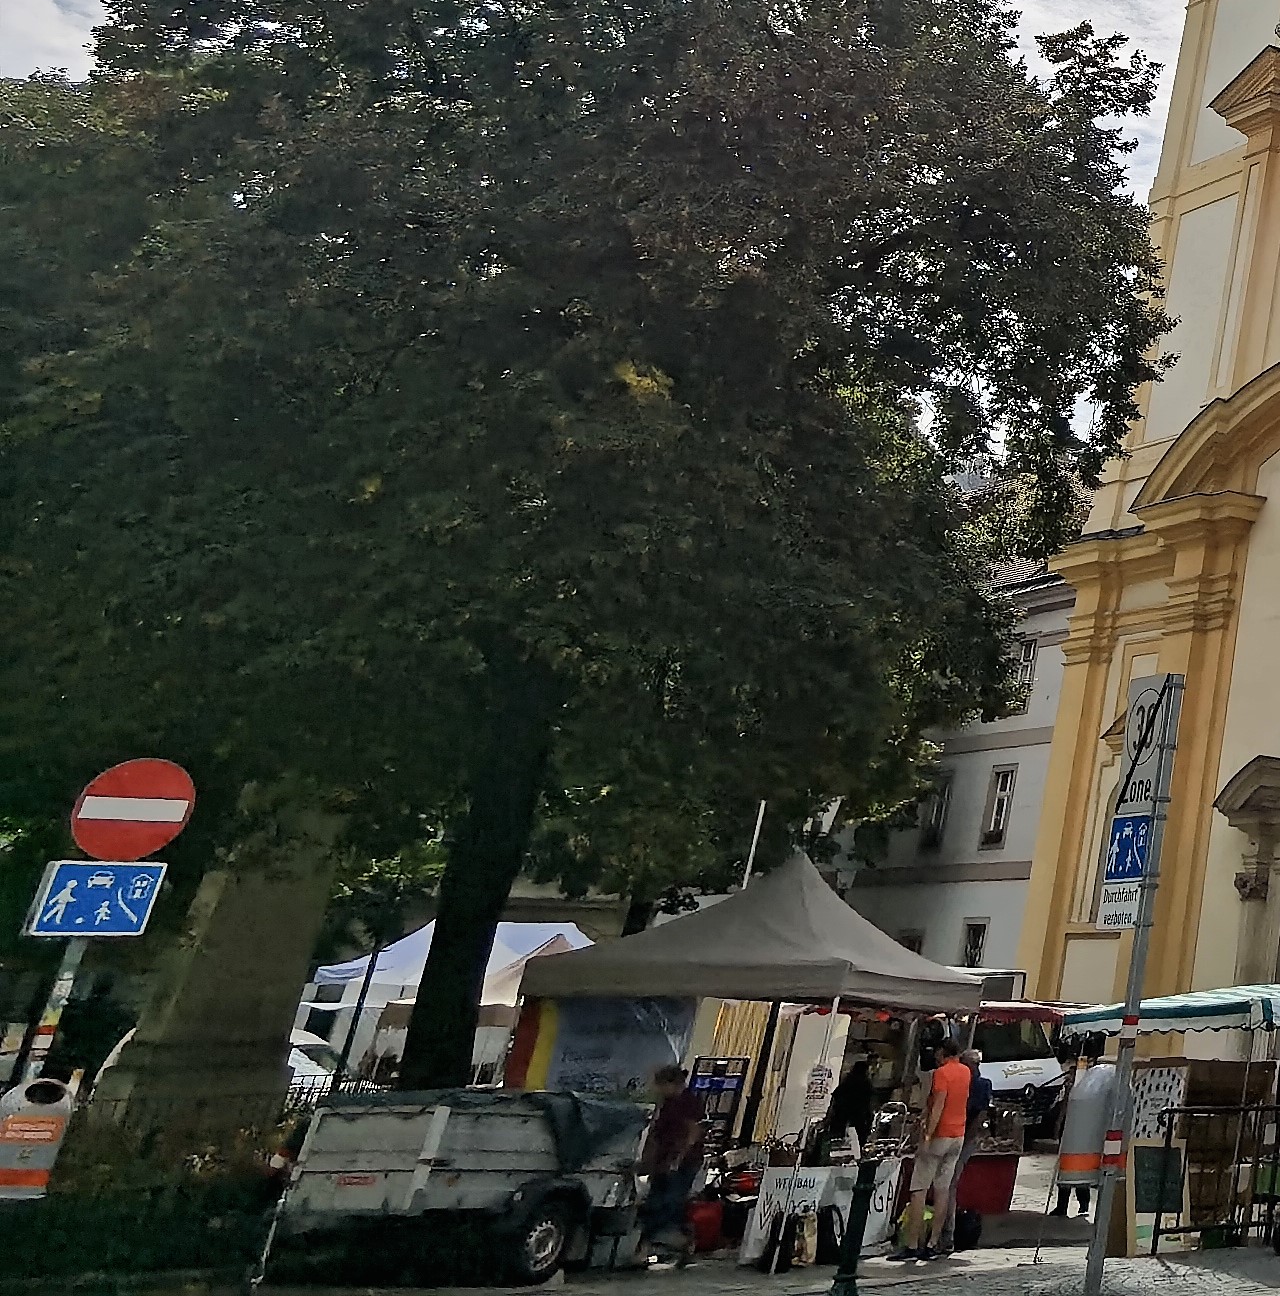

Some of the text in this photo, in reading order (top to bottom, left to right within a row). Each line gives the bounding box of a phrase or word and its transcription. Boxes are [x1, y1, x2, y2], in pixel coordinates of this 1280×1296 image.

[1133, 703, 1156, 751] 30
[1103, 887, 1139, 904] Durchfahrt
[1103, 910, 1132, 925] verboten
